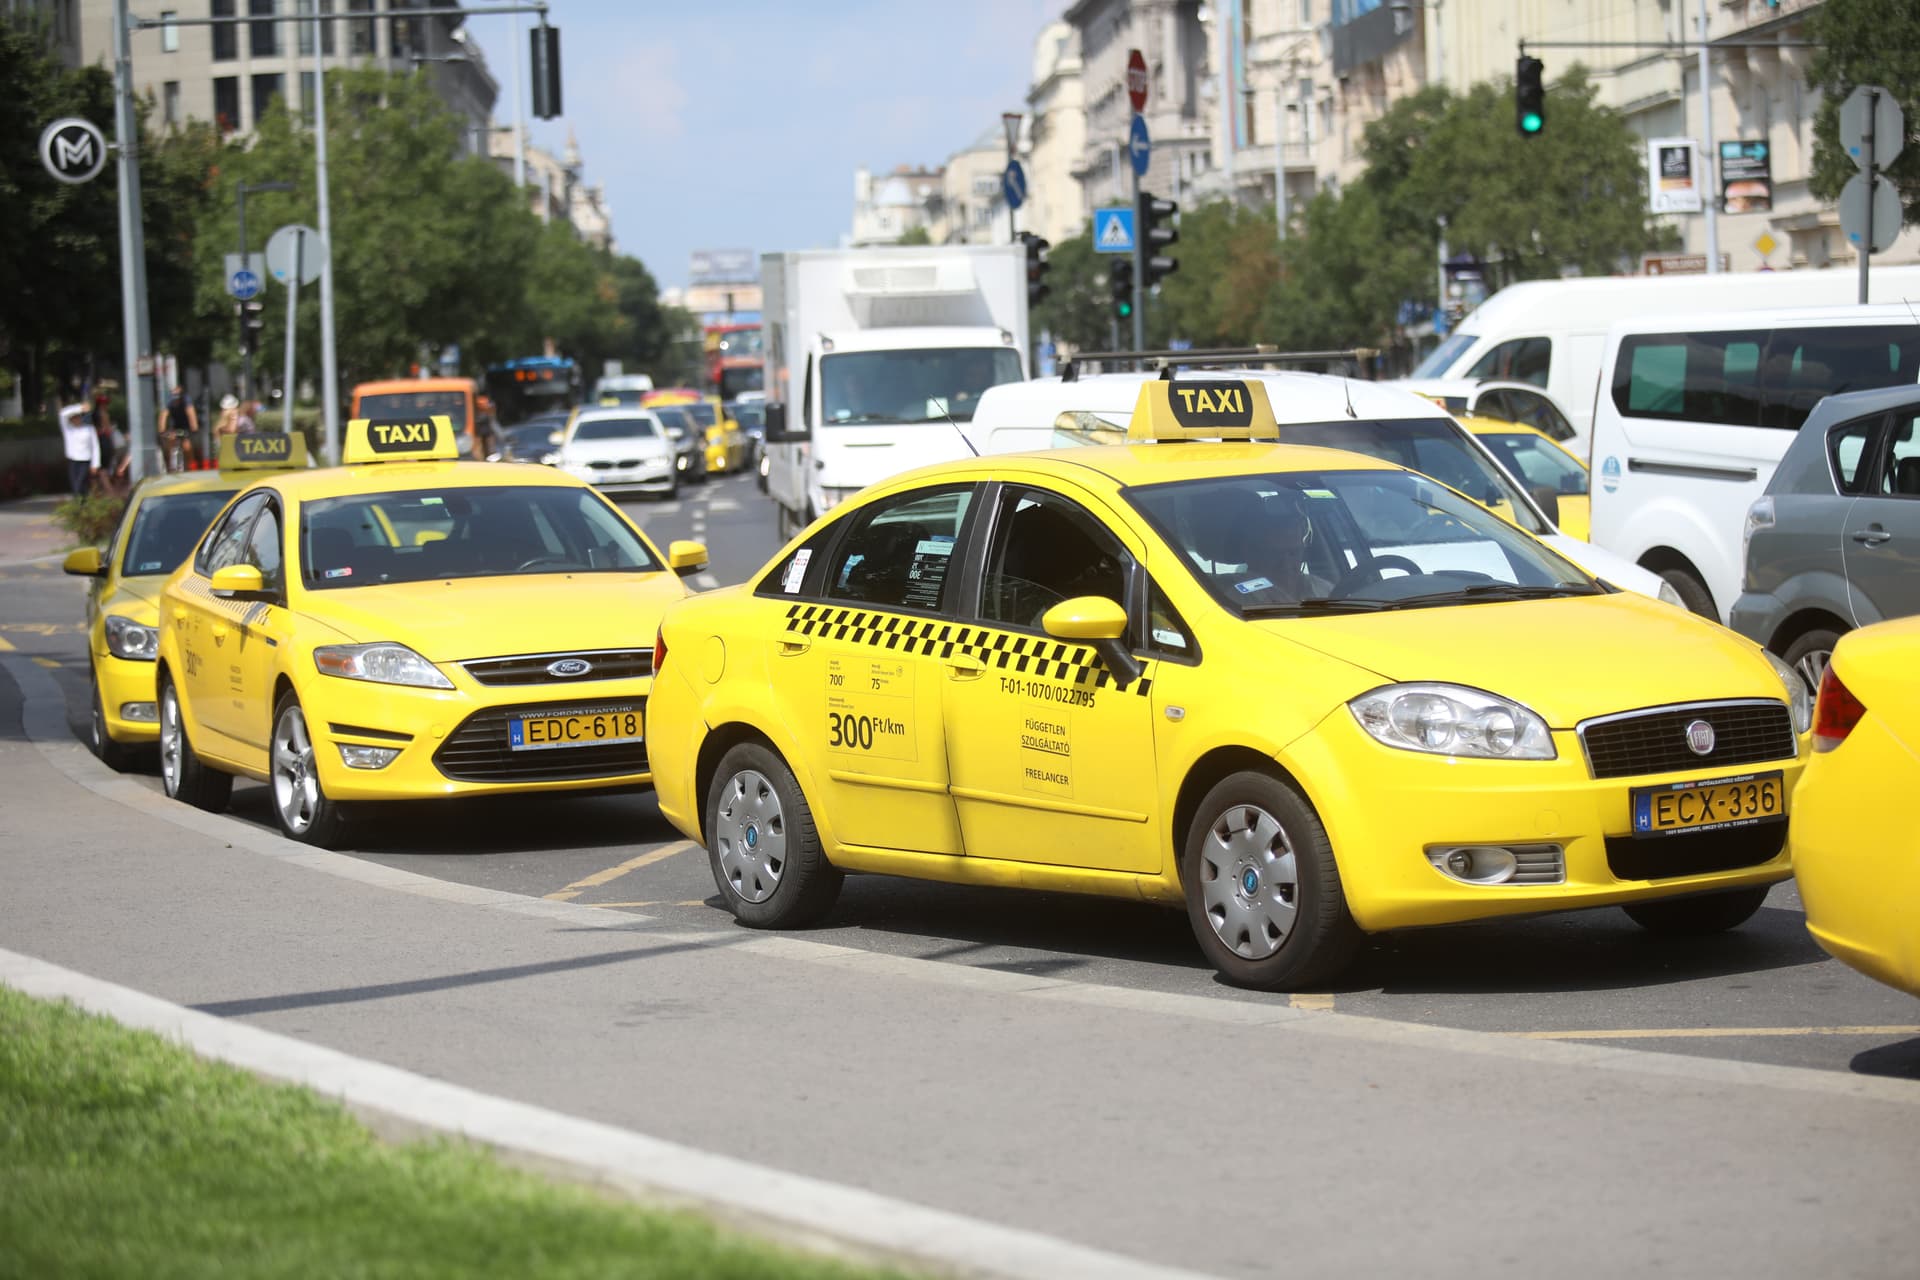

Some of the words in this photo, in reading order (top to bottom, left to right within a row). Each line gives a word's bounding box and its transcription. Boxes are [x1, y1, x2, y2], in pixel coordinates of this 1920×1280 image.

[1177, 389, 1244, 413] TAXI
[373, 424, 430, 444] TAXI
[241, 438, 286, 454] TAXI
[1000, 677, 1096, 708] T-01-1070/022795
[529, 713, 637, 742] EDC-618
[1025, 718, 1066, 737] FÜGGETLEN
[513, 734, 521, 743] H
[1021, 734, 1070, 753] SZOLGÁLTATÓ
[1694, 729, 1711, 746] FIAT
[1025, 767, 1070, 786] FREELANCER
[1657, 782, 1775, 826] ECX-336
[1639, 815, 1648, 826] H
